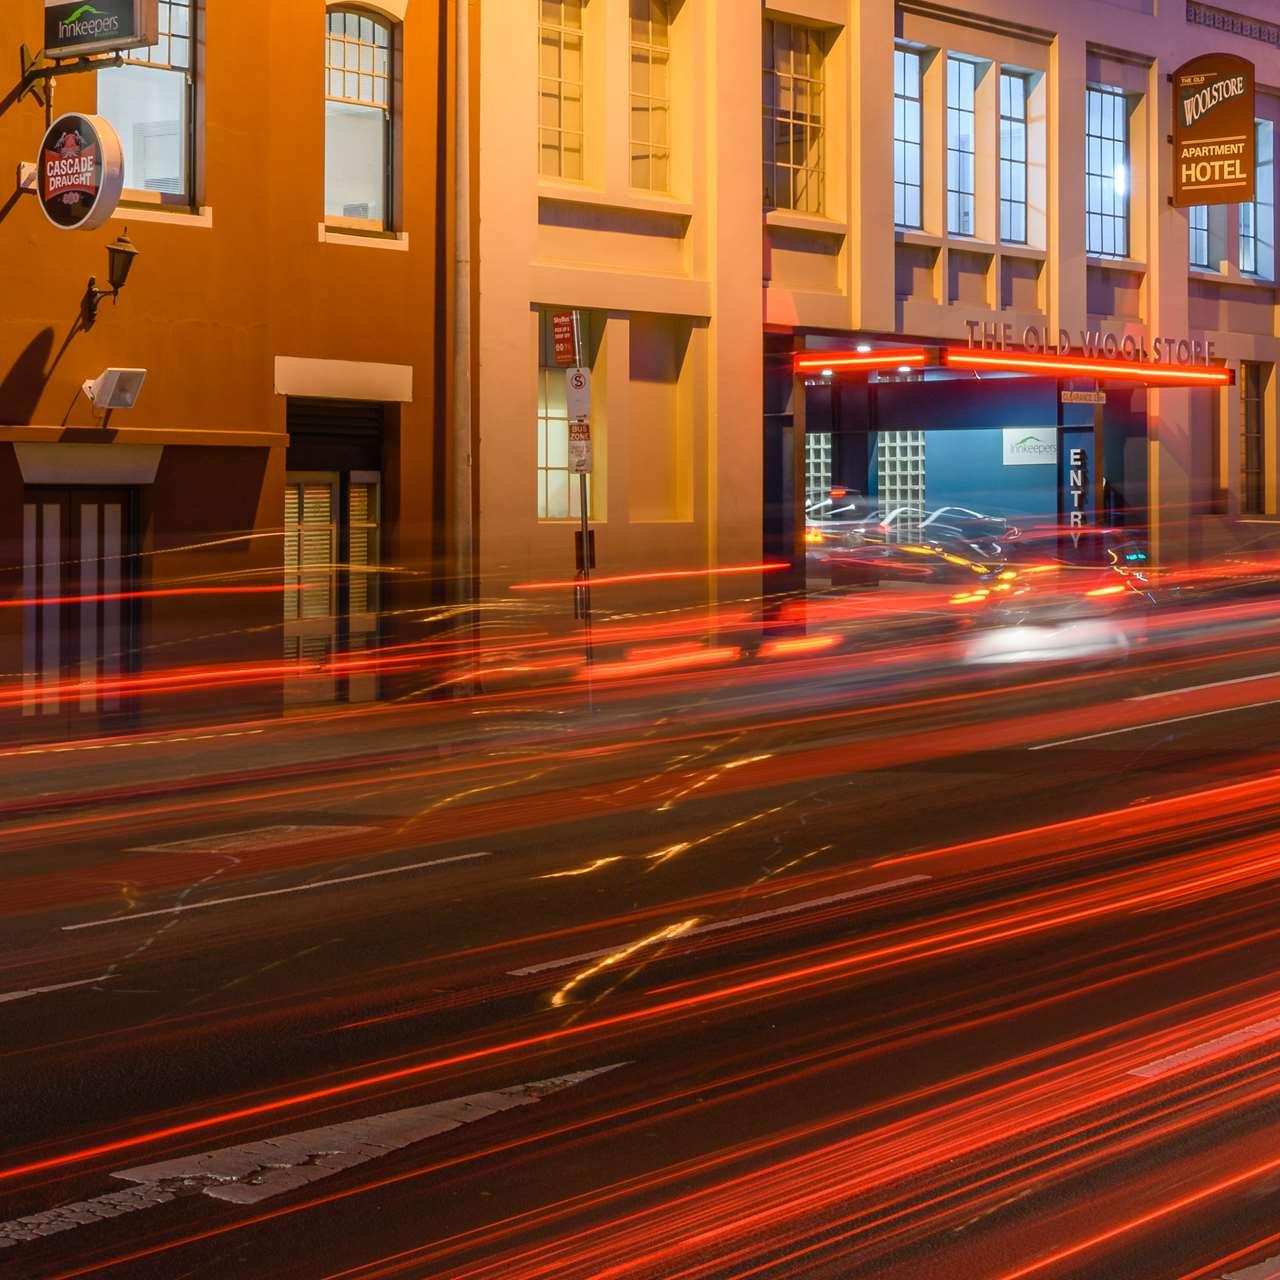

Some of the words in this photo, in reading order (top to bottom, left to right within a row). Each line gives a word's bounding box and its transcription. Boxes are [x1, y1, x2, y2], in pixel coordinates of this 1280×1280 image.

[58, 15, 119, 39] Innkeepers
[1183, 76, 1245, 127] WOOLSTORE
[1181, 143, 1245, 159] APARTMENT
[46, 155, 95, 177] CASCADE
[1181, 159, 1247, 184] HOTEL
[48, 172, 92, 191] DRAUGHT
[965, 320, 1013, 352] THE
[1022, 325, 1071, 356] OLD
[1080, 330, 1216, 368] WOOLSTORE
[1069, 448, 1082, 549] ENTRY
